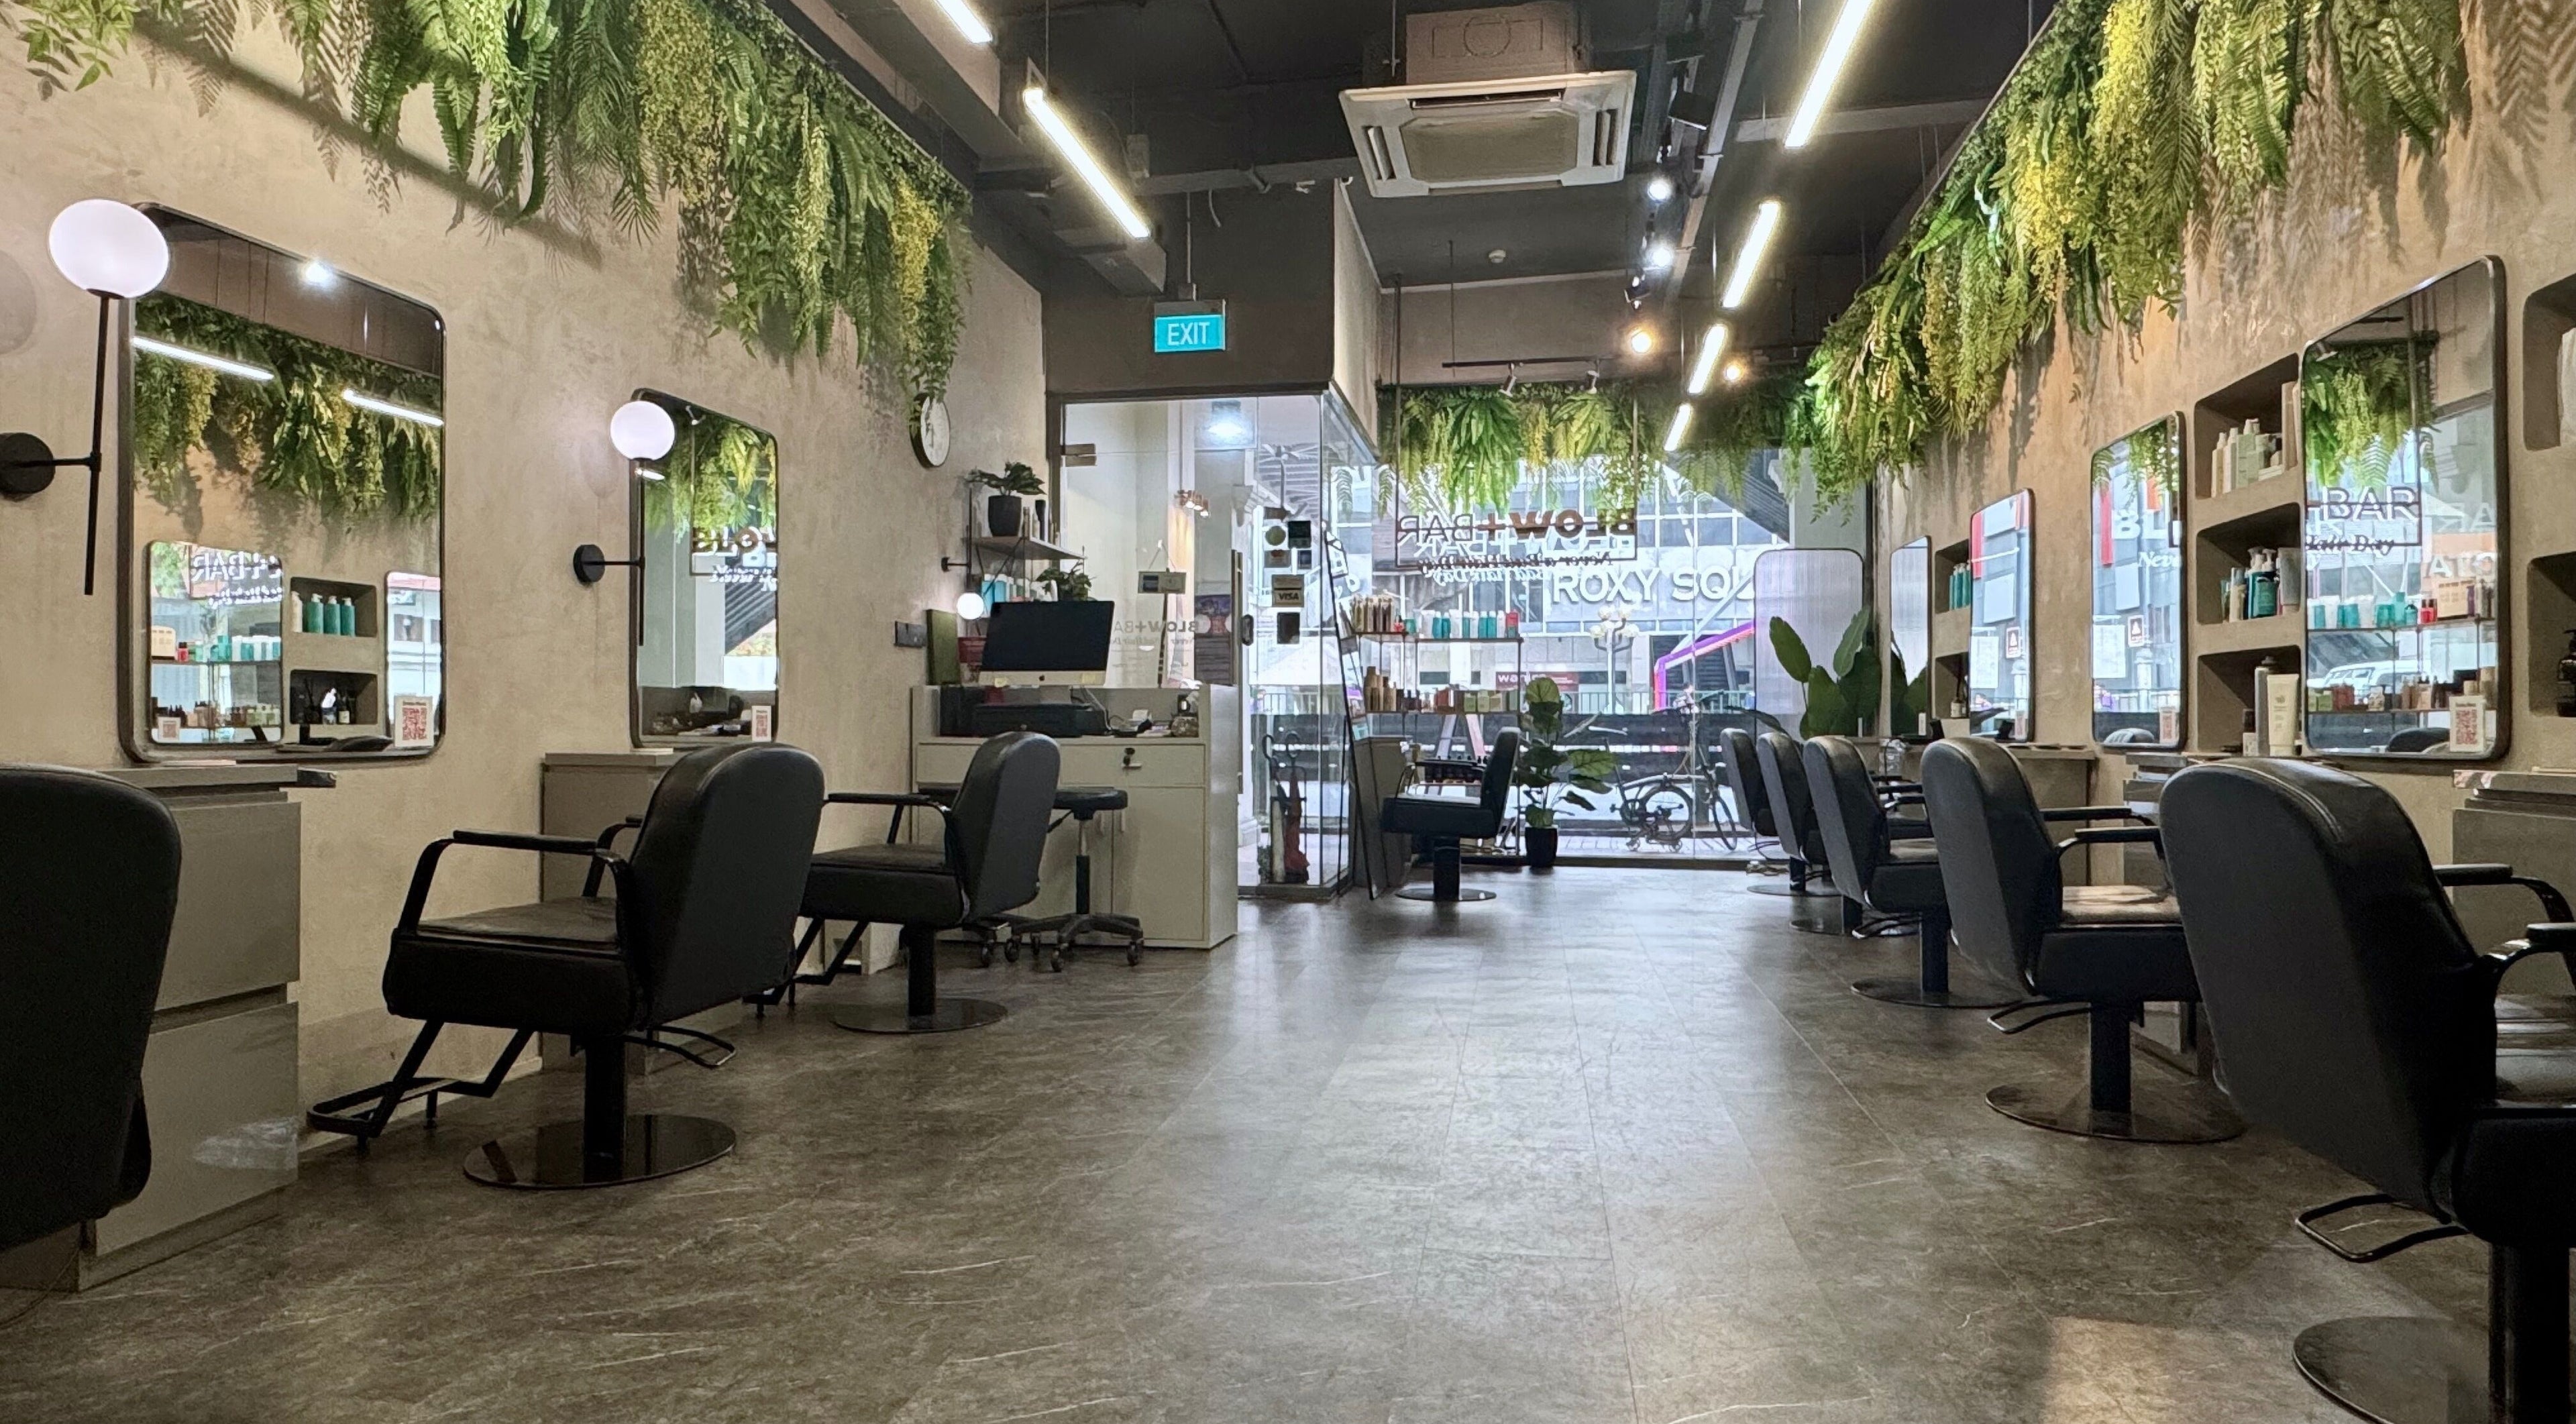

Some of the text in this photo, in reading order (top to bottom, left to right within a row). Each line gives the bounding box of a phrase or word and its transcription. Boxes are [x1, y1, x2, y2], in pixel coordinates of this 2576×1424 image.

[1168, 322, 1211, 346] EXIT
[1278, 592, 1299, 601] VISA
[1552, 567, 1660, 602] ROXY
